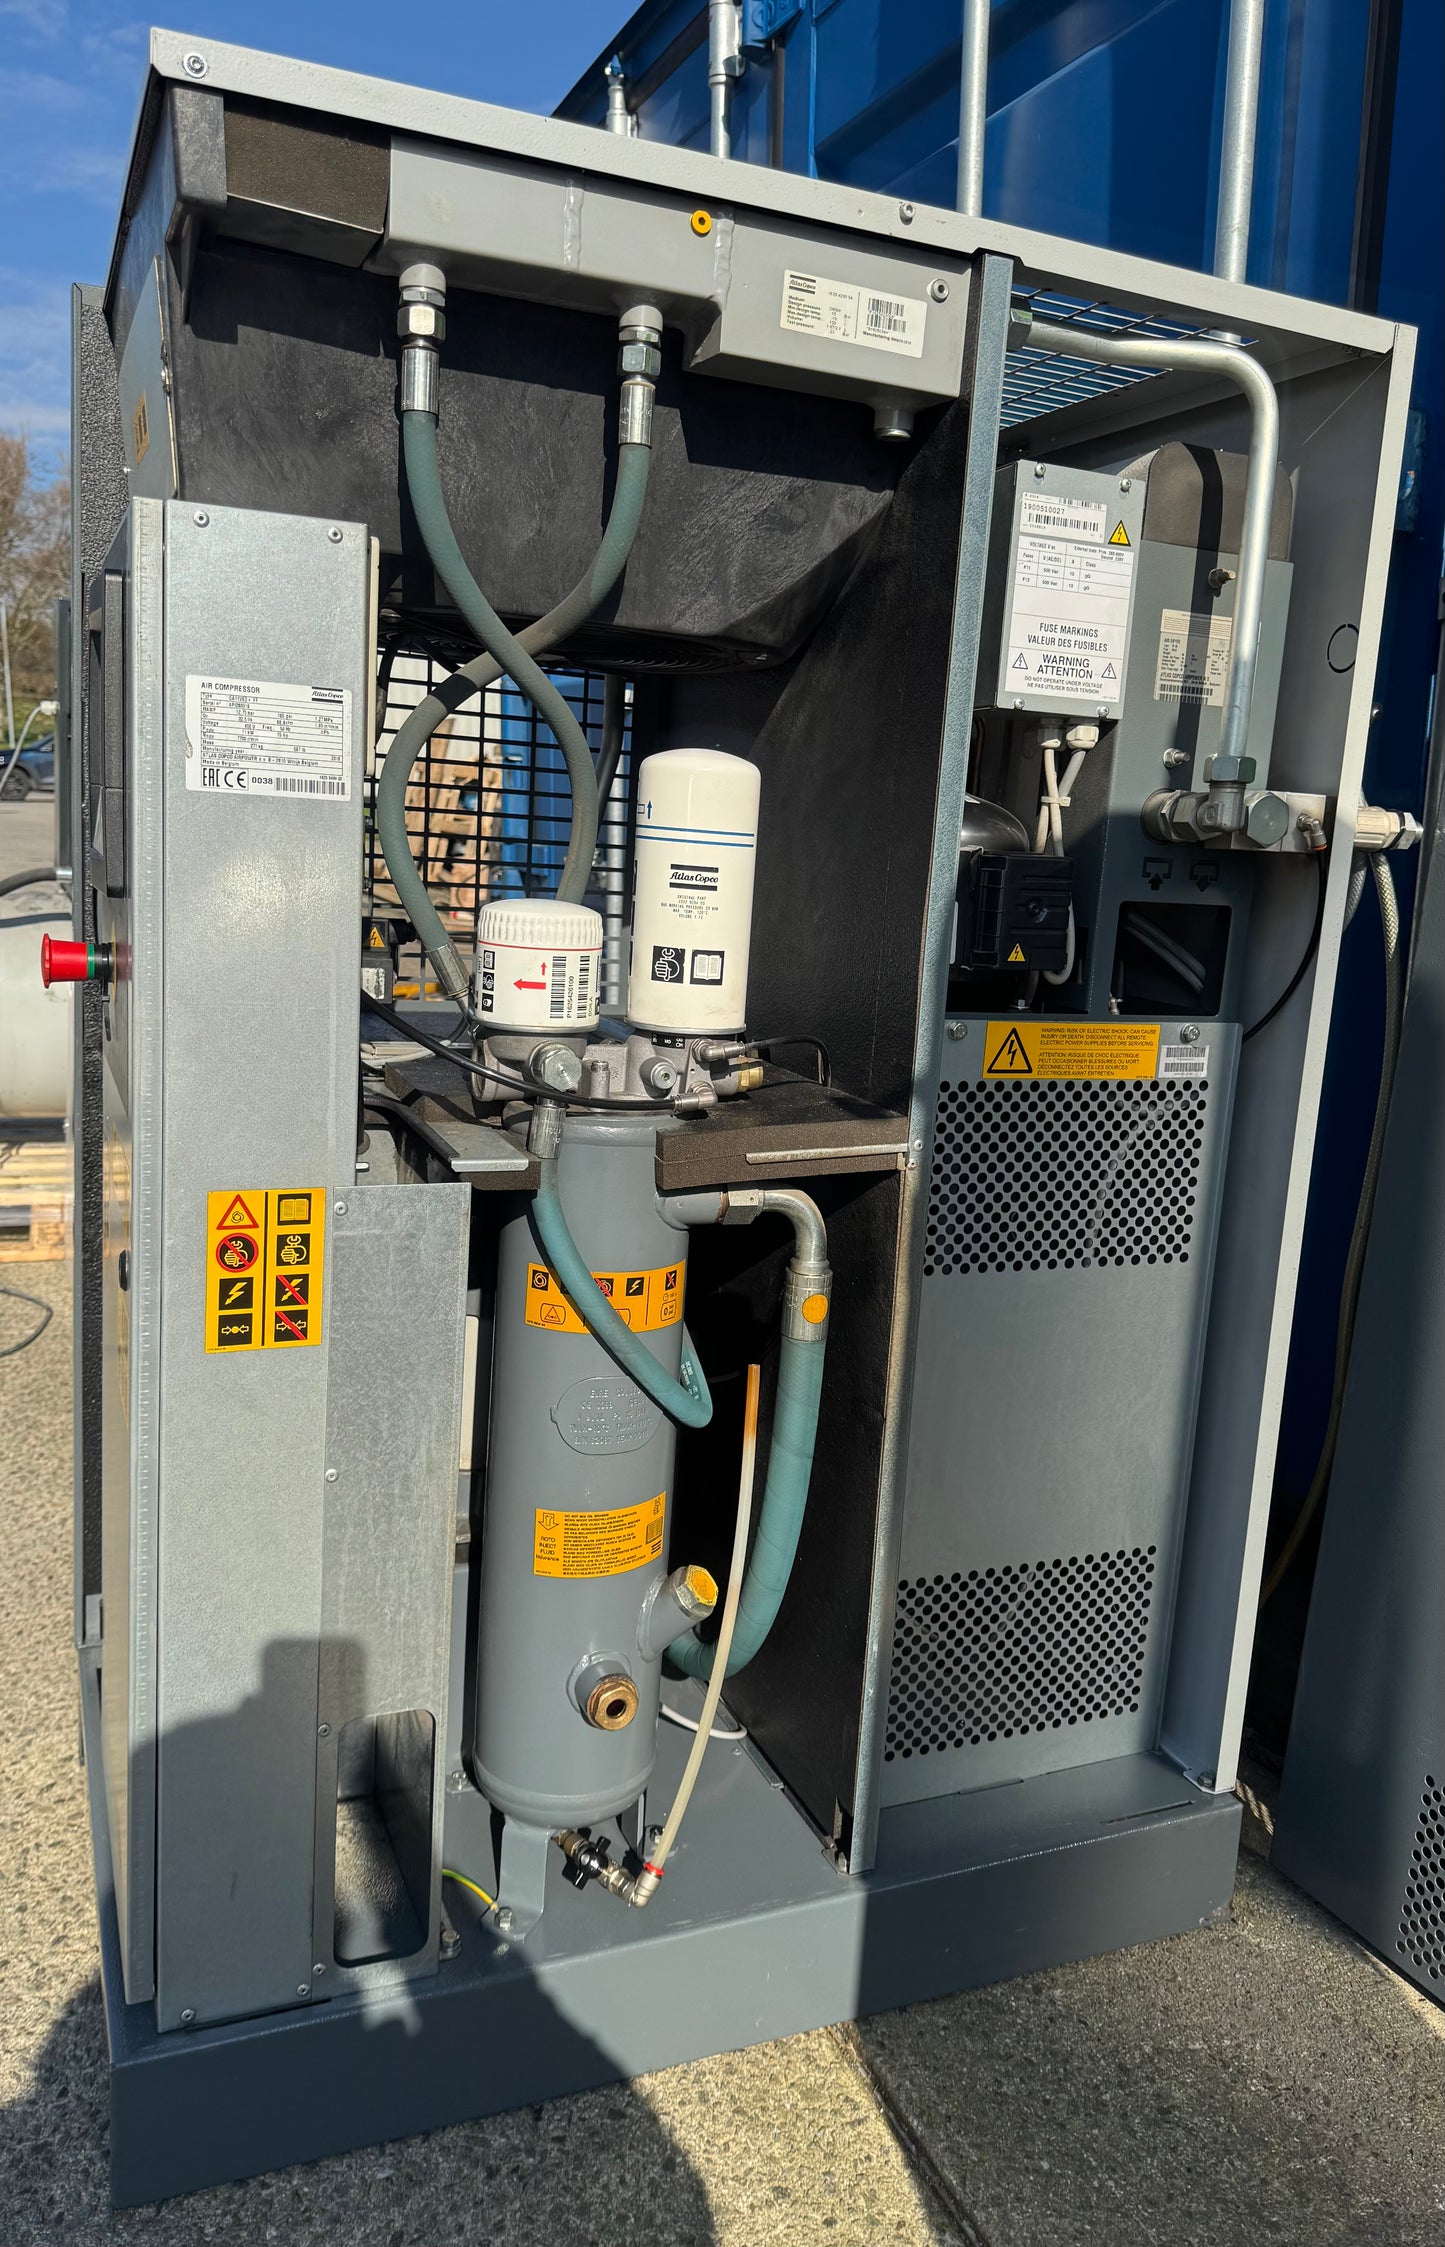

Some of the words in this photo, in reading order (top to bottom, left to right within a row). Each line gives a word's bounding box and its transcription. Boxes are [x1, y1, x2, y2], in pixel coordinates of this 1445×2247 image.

[1023, 502, 1065, 515] 1900510027
[1039, 622, 1058, 634] FUSE
[1060, 625, 1099, 639] MARKINGS
[1027, 634, 1056, 646] VALEUR
[1057, 638, 1072, 648] DES
[1074, 640, 1108, 653] FUSIBLES
[1042, 653, 1090, 668] WARNING
[1037, 664, 1093, 680] ATTENTION
[201, 682, 212, 690] AIR
[215, 683, 260, 693] COMPRESSOR
[1043, 677, 1065, 685] OPERATE
[1082, 681, 1103, 689] VOLTAGE
[1044, 684, 1066, 692] UTILISER
[1080, 687, 1100, 695] TENSION
[252, 776, 273, 785] 0038
[670, 871, 694, 881] Atlas
[695, 873, 718, 883] Copco
